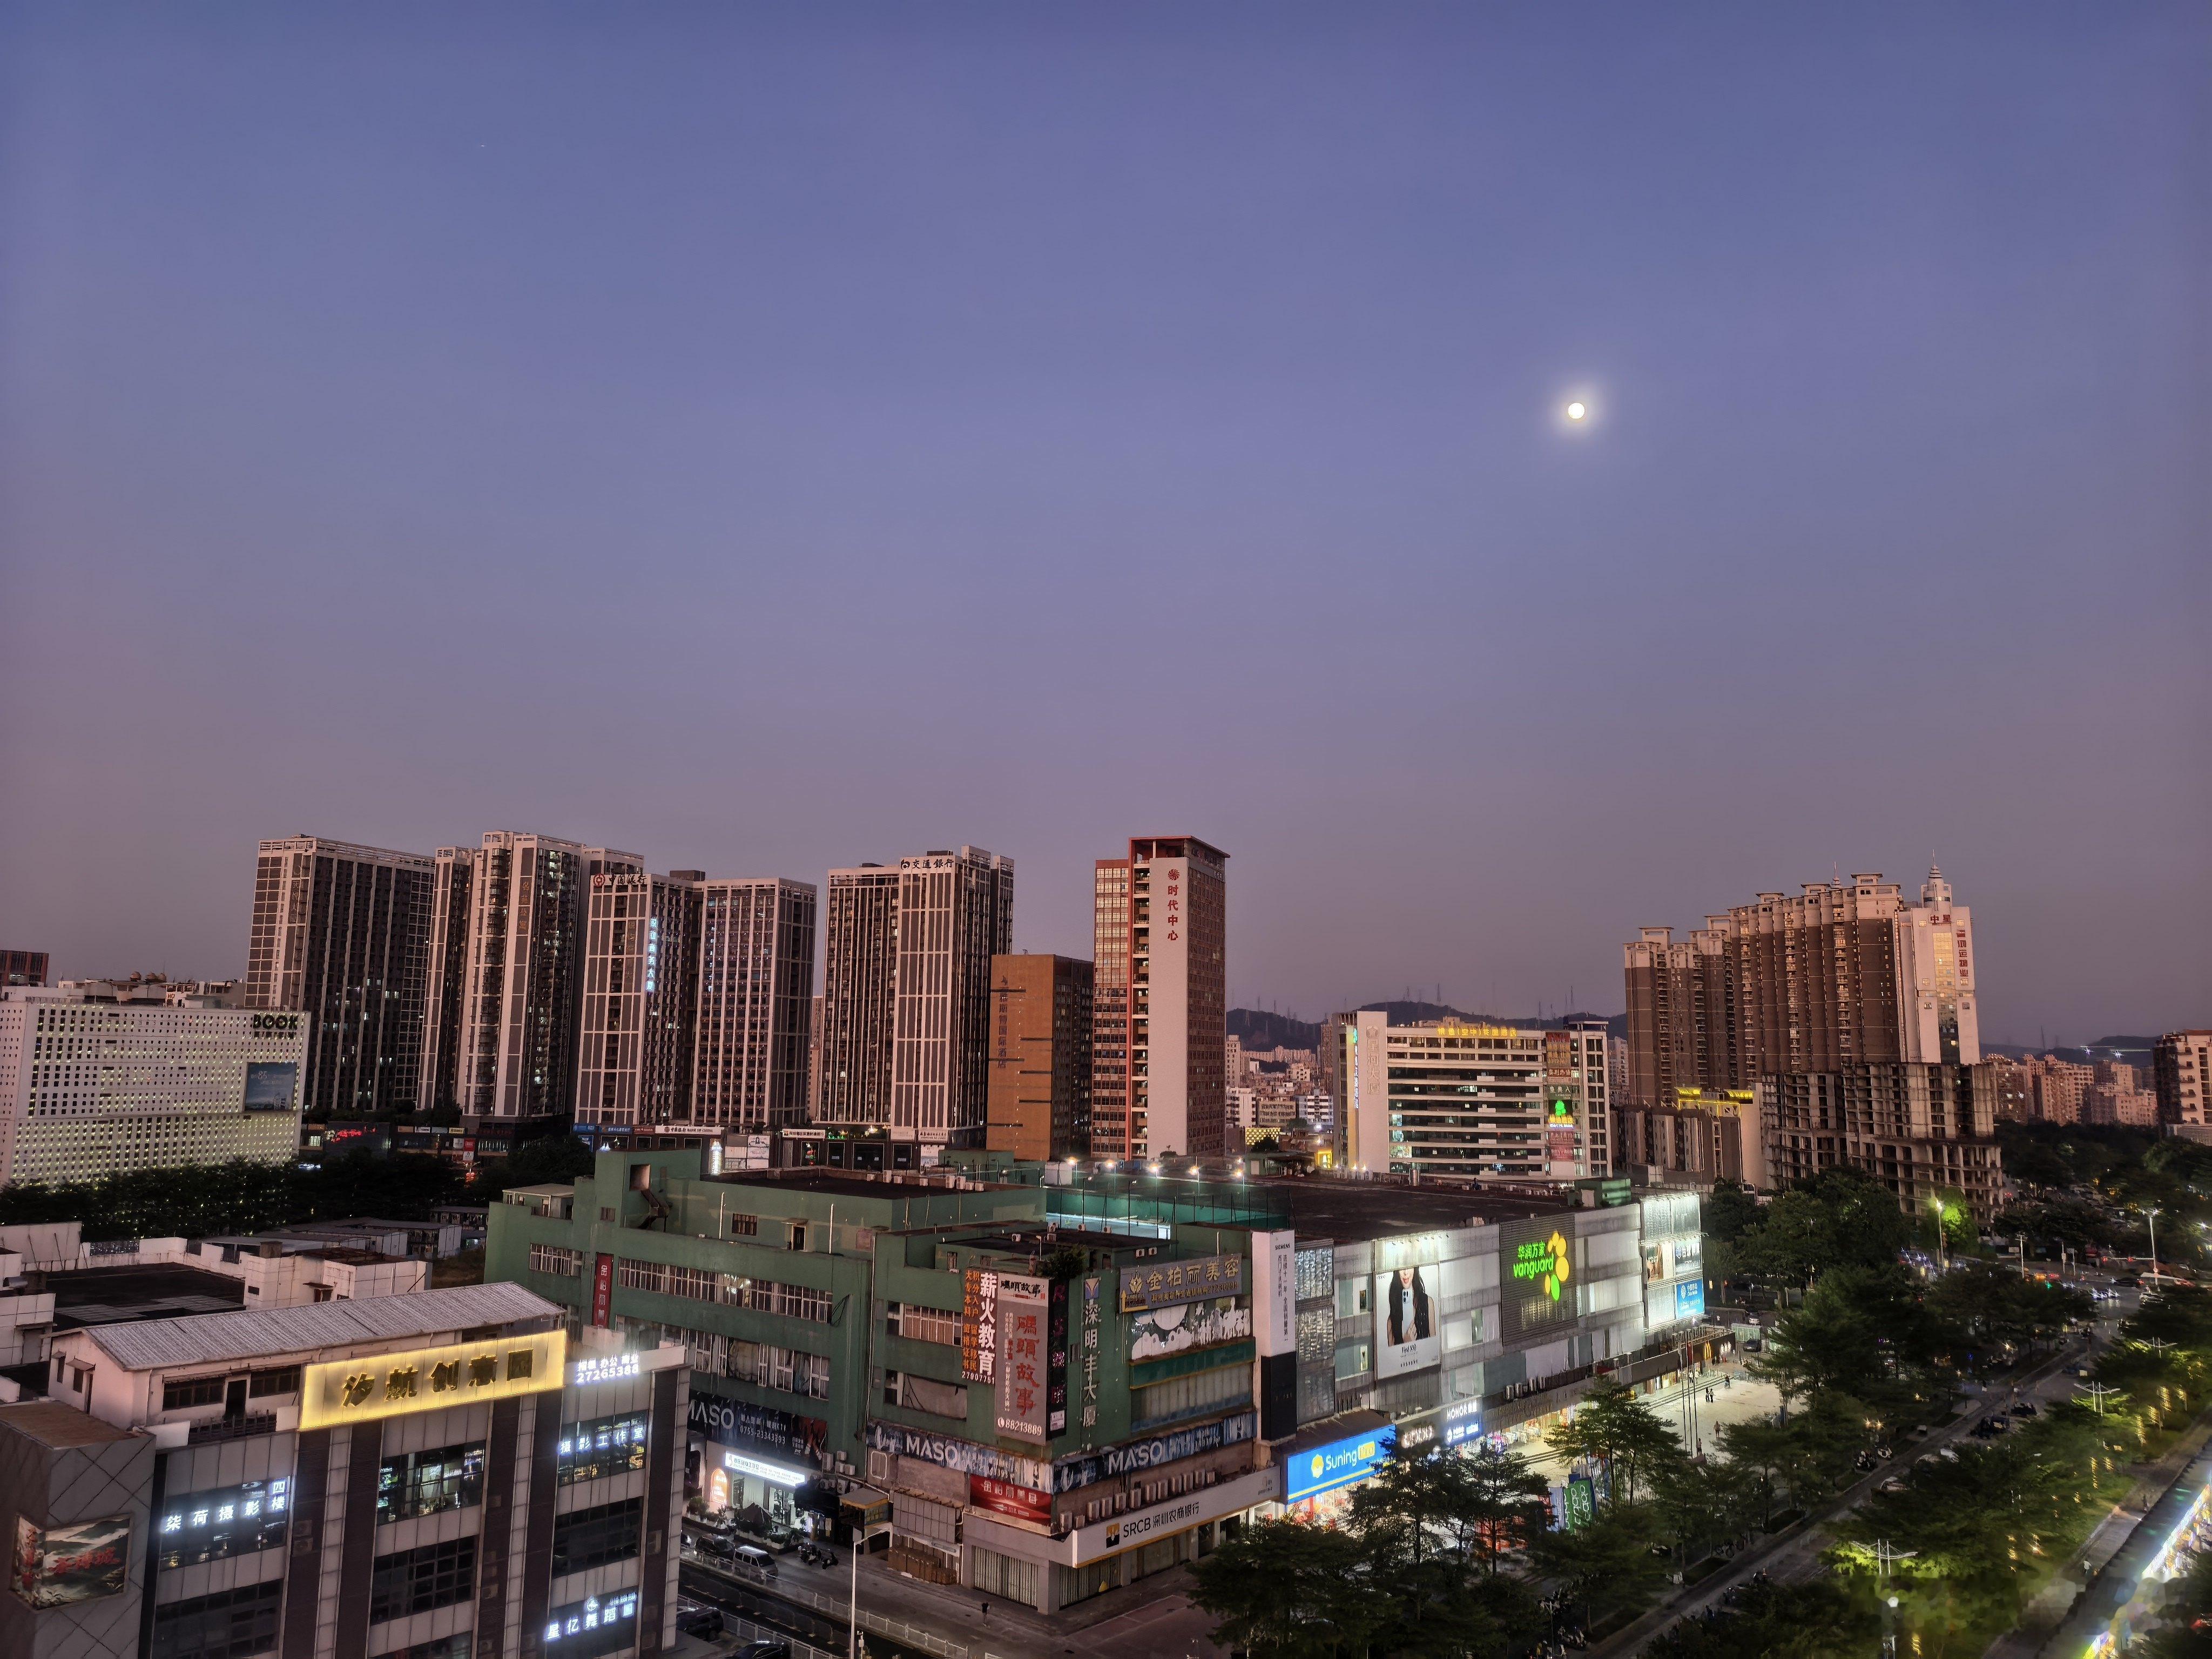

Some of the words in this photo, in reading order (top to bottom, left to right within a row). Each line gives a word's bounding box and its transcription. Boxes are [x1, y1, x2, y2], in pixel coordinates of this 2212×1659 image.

[1168, 885, 1178, 941] 时代中心
[1931, 915, 1951, 924] 中星
[253, 1014, 298, 1029] BOOK
[1518, 1240, 1545, 1260] 华润万家
[1147, 1257, 1239, 1292] 金柏丽美容
[1513, 1252, 1554, 1279] vanguard
[977, 1272, 997, 1377] 薪火教育
[576, 1364, 639, 1383] 27265388
[1447, 1404, 1467, 1421] HONOR
[561, 1427, 643, 1454] 摄影工作室
[906, 1433, 958, 1466] MASO
[1109, 1442, 1162, 1474] MASO
[1326, 1449, 1358, 1471] Suning
[1360, 1445, 1374, 1458] Pro
[165, 1500, 259, 1532] 柒荷摄影
[1123, 1518, 1151, 1538] SRCB
[1152, 1501, 1199, 1528] 深圳农商银行
